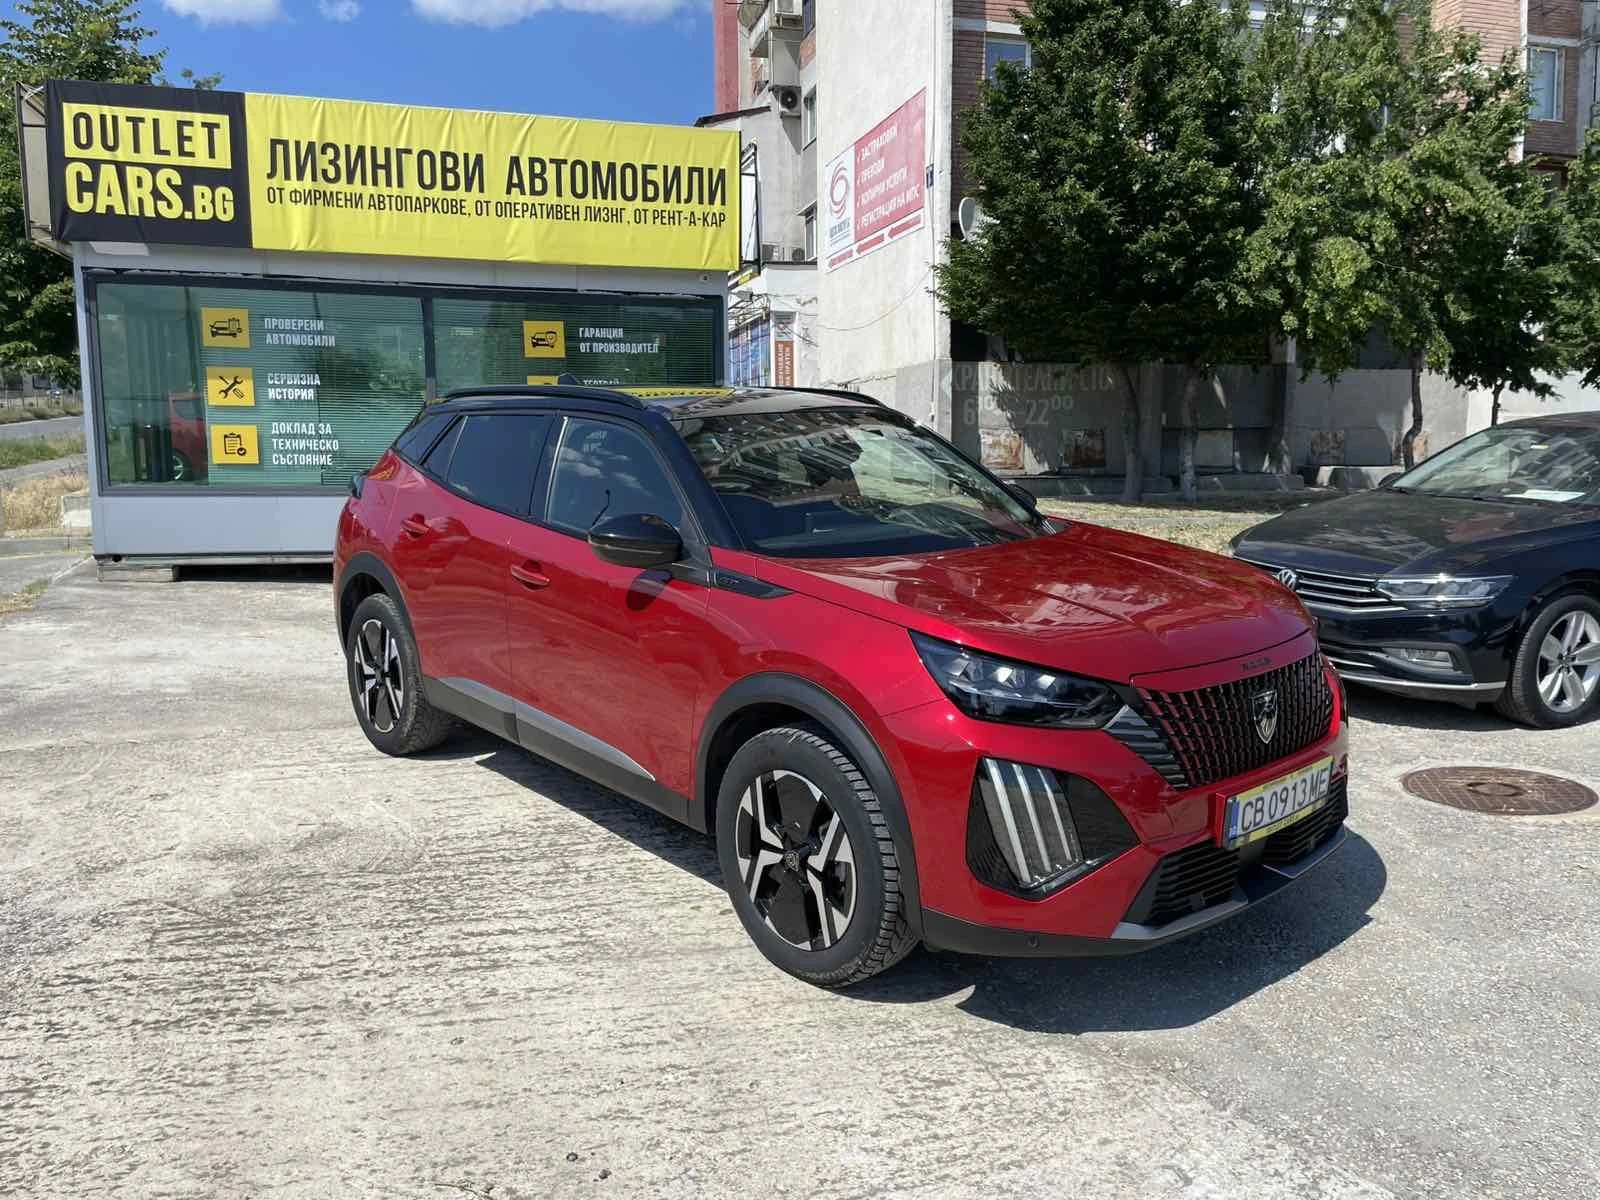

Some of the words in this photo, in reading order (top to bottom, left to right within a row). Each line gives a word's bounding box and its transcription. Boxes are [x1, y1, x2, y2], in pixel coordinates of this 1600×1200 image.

[72, 111, 221, 160] OUTLET
[266, 138, 485, 193] ЛИЗИНГОВИ
[505, 155, 727, 206] АВТОМОБИЛИ
[64, 161, 235, 222] CARS.BG
[267, 186, 285, 205] ОТ
[289, 188, 364, 210] ФИРМЕНИ
[367, 193, 471, 217] АВТОПАРКОВЕ,
[474, 200, 492, 217] ОТ
[495, 201, 580, 221] ОПЕРАТИВЕН
[634, 208, 649, 225] ОТ
[653, 209, 726, 228] РЕНТ-А-КАР
[264, 318, 325, 331] ПРОВЕРЕНИ
[579, 327, 624, 339] ГАРАНЦИЯ
[265, 333, 336, 347] АВТОМОБИЛИ
[579, 343, 591, 353] ОТ
[592, 343, 659, 354] ПРОИЗВОДИТЕЛ
[267, 373, 321, 385] СЕРВИЗНА
[268, 388, 315, 400] ИСТОРИЯ
[271, 422, 316, 435] ДОКЛАД
[318, 423, 333, 435] ЗА
[272, 438, 340, 451] ТЕХНИЧЕСКО
[272, 454, 333, 466] СЪСТОЯНИЕ
